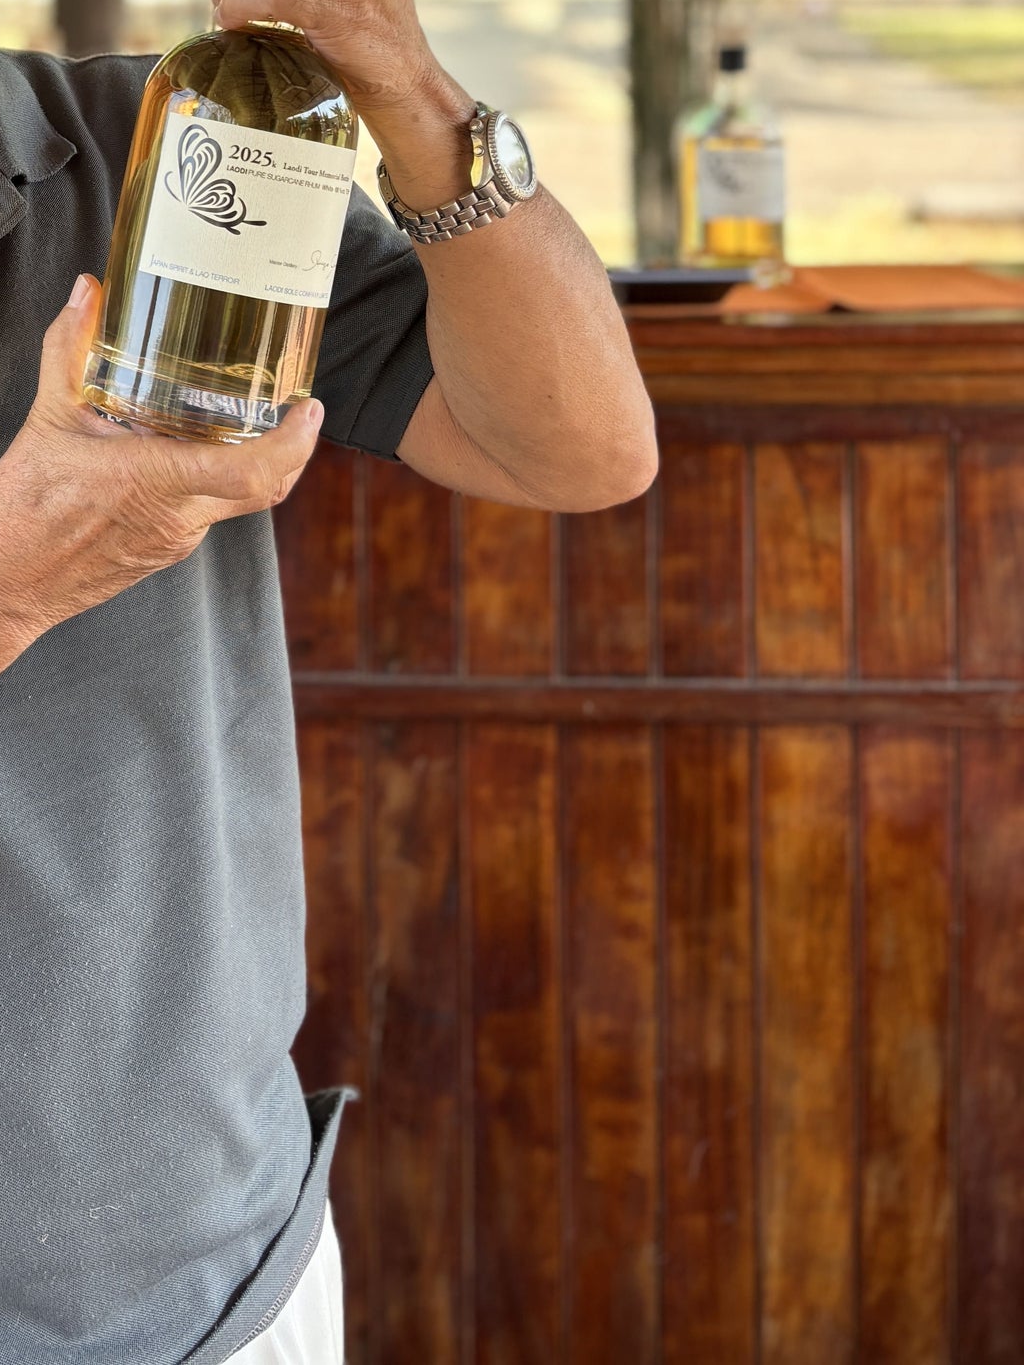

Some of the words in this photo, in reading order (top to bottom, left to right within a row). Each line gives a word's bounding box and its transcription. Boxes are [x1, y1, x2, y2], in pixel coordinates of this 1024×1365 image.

[282, 162, 302, 173] Laodi
[226, 165, 248, 175] LAODI
[248, 169, 266, 179] PURE
[266, 172, 305, 187] SUGARCANE
[149, 254, 168, 269] JAPAN
[169, 263, 189, 274] SPIRIT
[195, 270, 209, 279] LAO
[211, 273, 240, 285] TERROIR
[264, 284, 283, 293] LAODI
